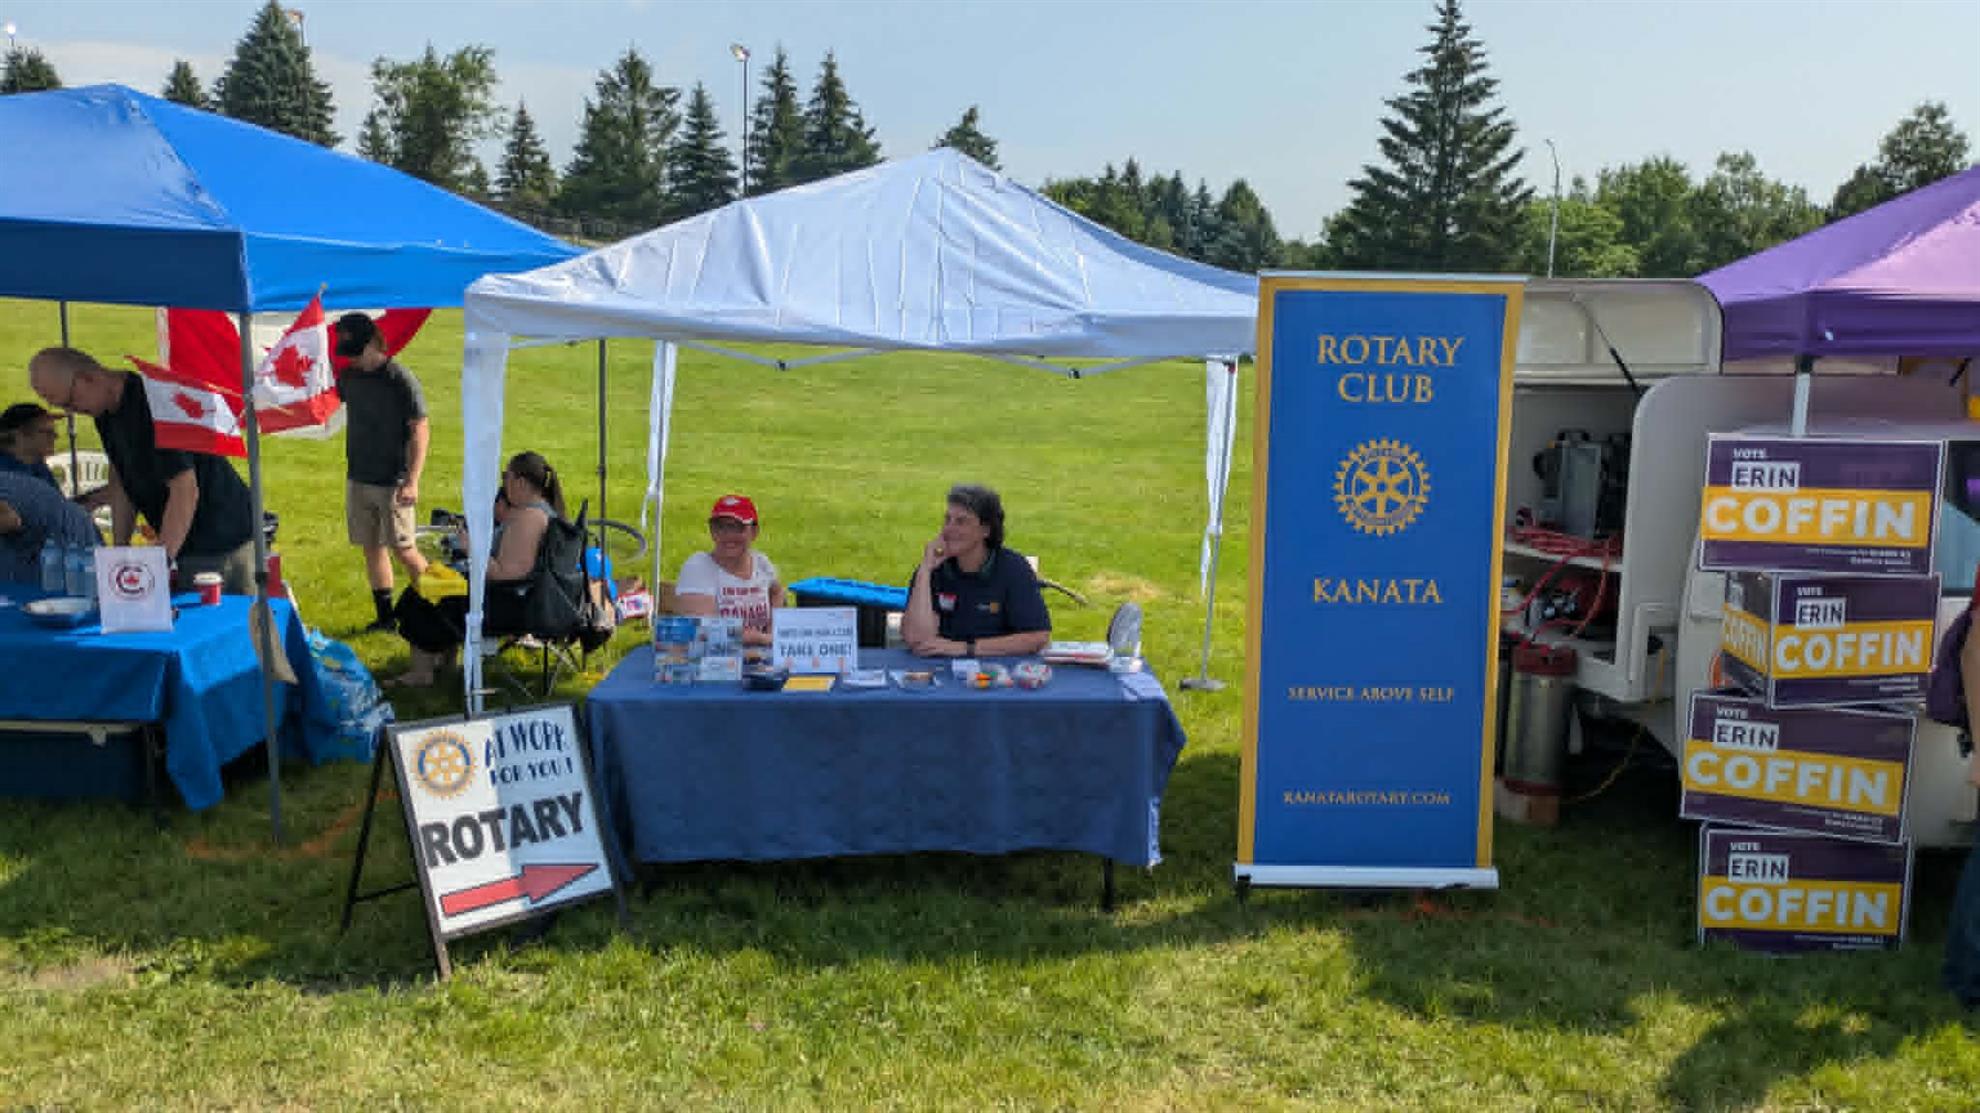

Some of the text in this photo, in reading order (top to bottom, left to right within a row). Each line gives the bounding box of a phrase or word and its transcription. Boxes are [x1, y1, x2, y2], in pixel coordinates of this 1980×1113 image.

[1317, 334, 1465, 367] ROTARY
[1337, 372, 1435, 404] CLUB
[1733, 448, 1766, 459] VOTE
[1734, 464, 1796, 488] ERIN
[1706, 496, 1915, 539] COFFIN
[1313, 578, 1444, 604] KANATA
[1797, 586, 1824, 596] VOTE
[1799, 601, 1843, 625] ERIN
[1775, 630, 1923, 671] COFFIN
[1287, 686, 1455, 701] SERVICE ABOVE SELF
[1716, 705, 1749, 719] VOTE
[509, 720, 567, 753] WORK
[1716, 722, 1778, 747] ERIN
[489, 764, 522, 786] FOR
[1686, 751, 1889, 806] COFFIN
[420, 791, 584, 869] ROTARY
[1730, 841, 1762, 852] VOTE
[1731, 857, 1786, 880] ERIN
[1705, 885, 1889, 928] COFFIN
